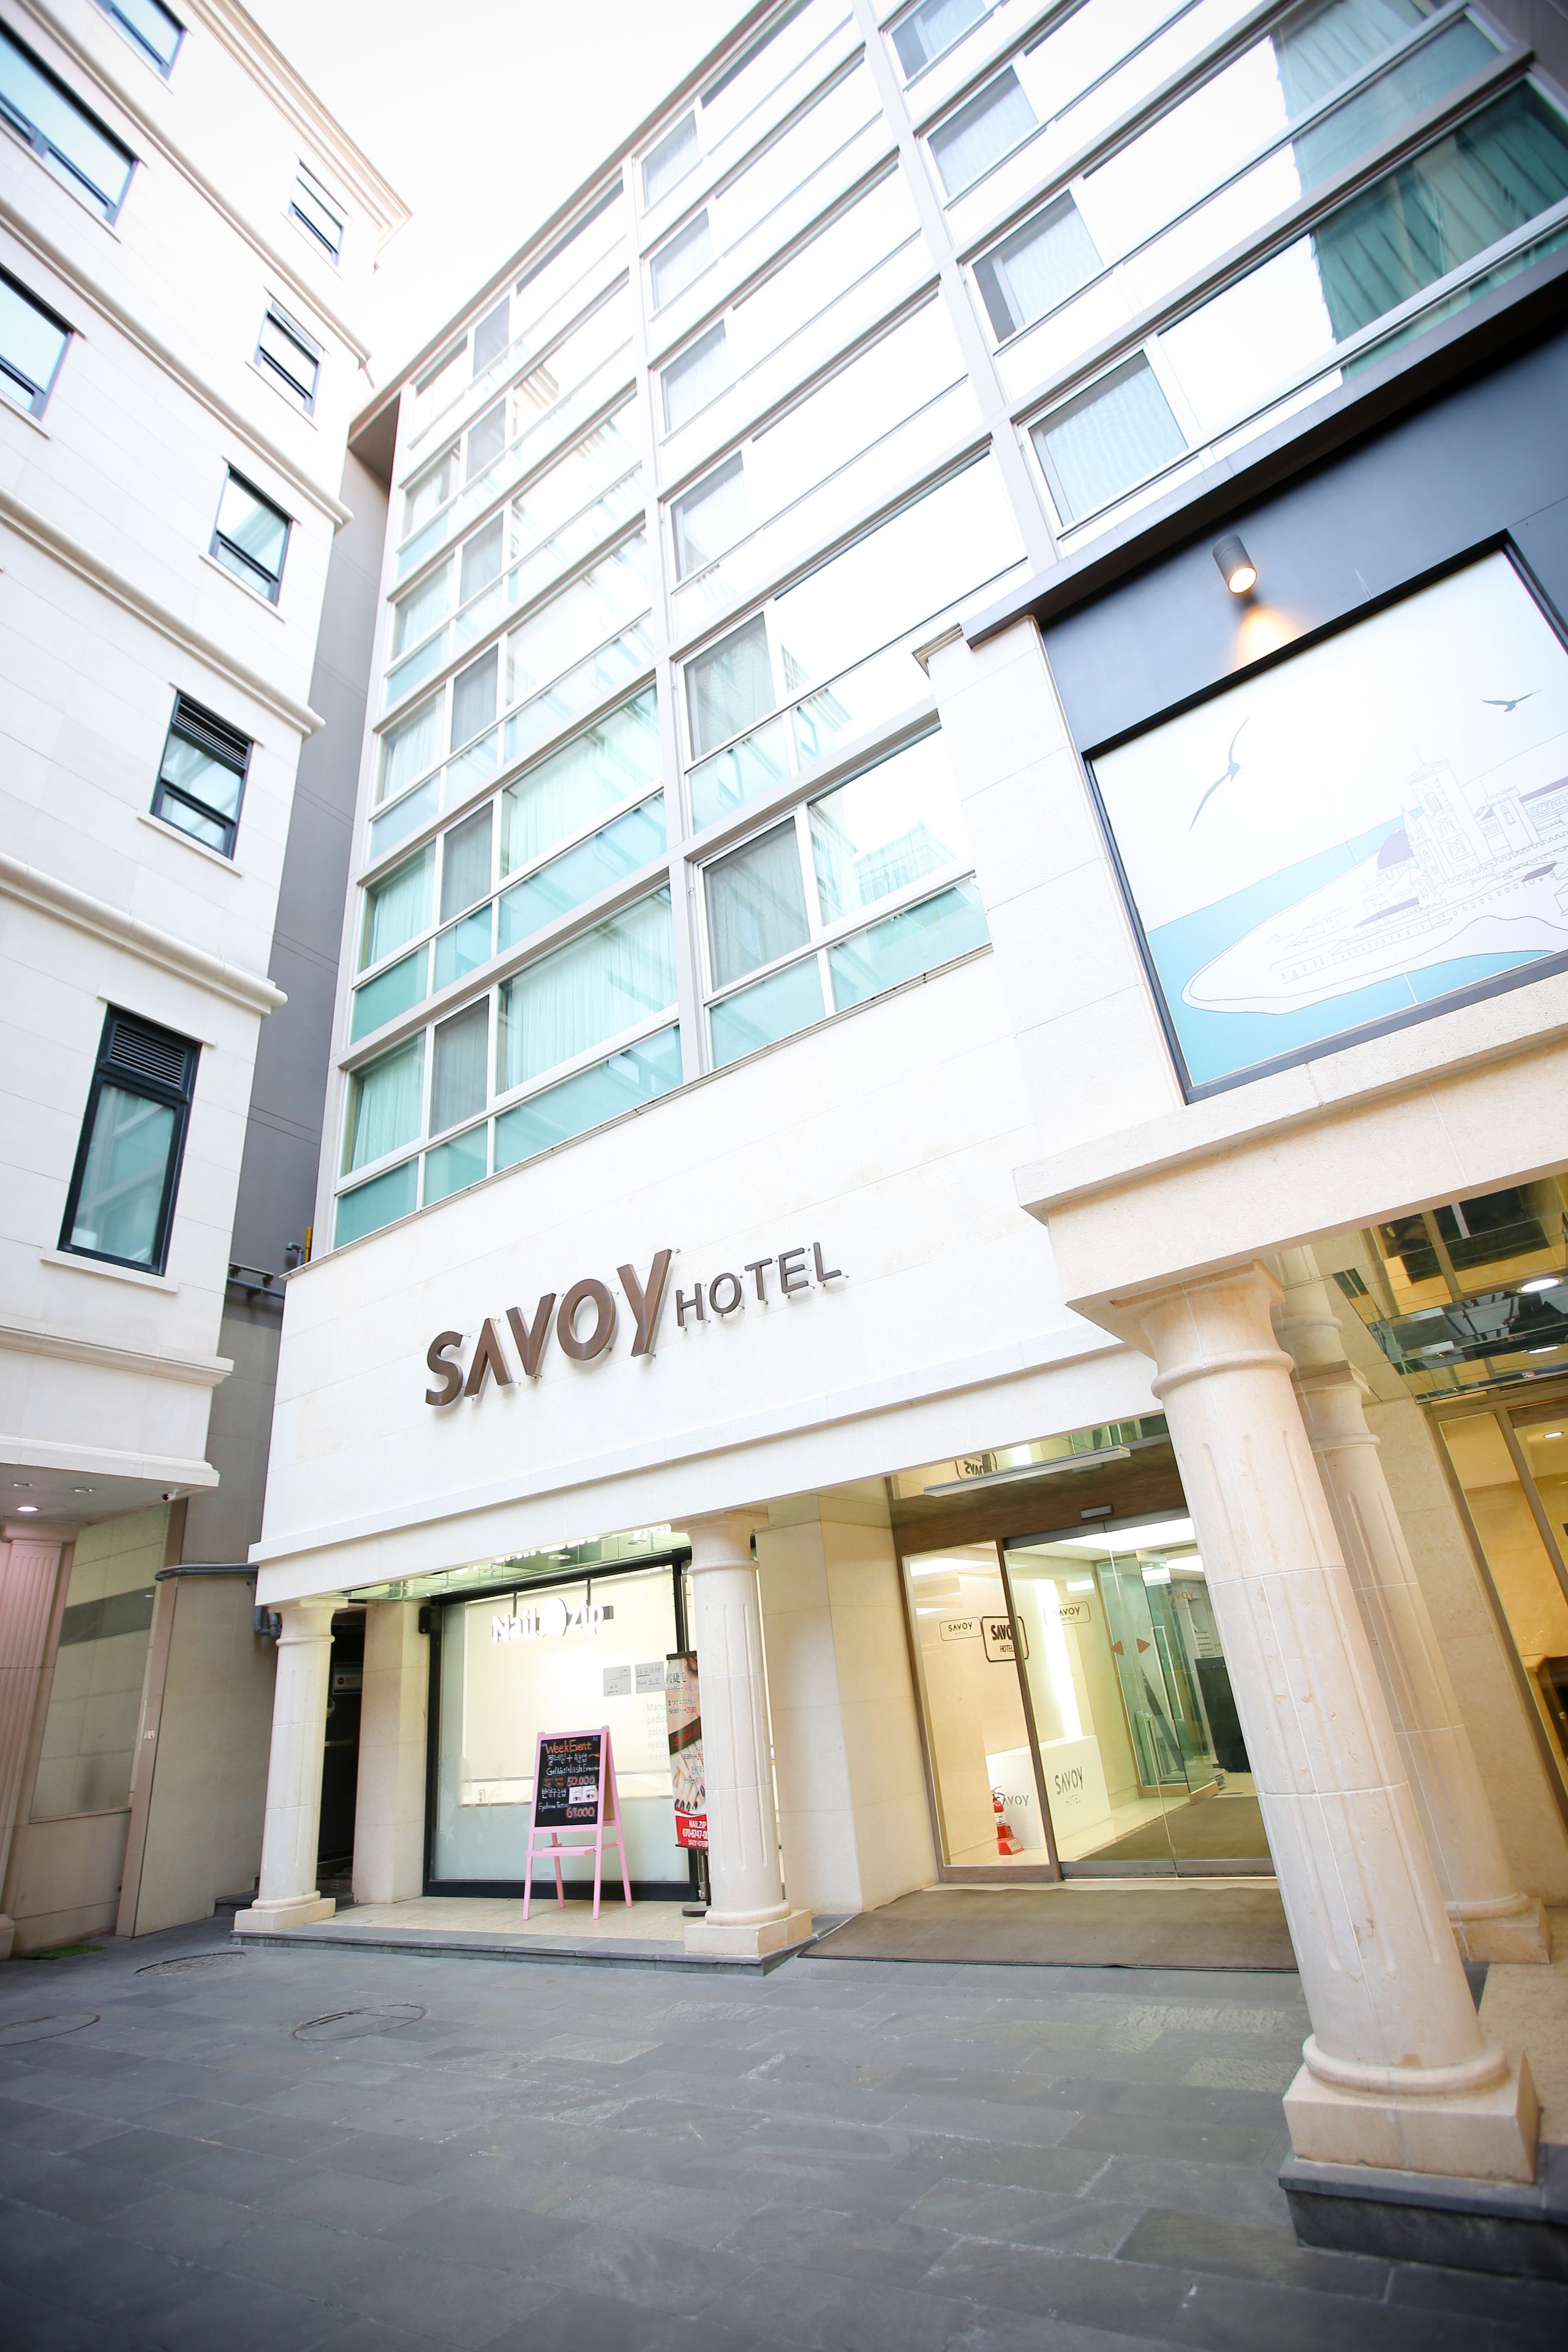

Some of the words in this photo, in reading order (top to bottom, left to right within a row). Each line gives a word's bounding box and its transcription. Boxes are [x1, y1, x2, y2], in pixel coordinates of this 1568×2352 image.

[425, 1249, 673, 1406] SAVOY
[675, 1242, 842, 1328] HOTEL
[1164, 1591, 1194, 1602] SAVOY
[492, 1607, 537, 1644] Nail
[568, 1599, 604, 1637] zip
[948, 1622, 973, 1632] SAVOY
[990, 1624, 1012, 1640] SAVO
[647, 1702, 666, 1711] Manic
[647, 1716, 666, 1725] pedic
[545, 1740, 569, 1754] Week
[1055, 1766, 1083, 1795] SAVOY
